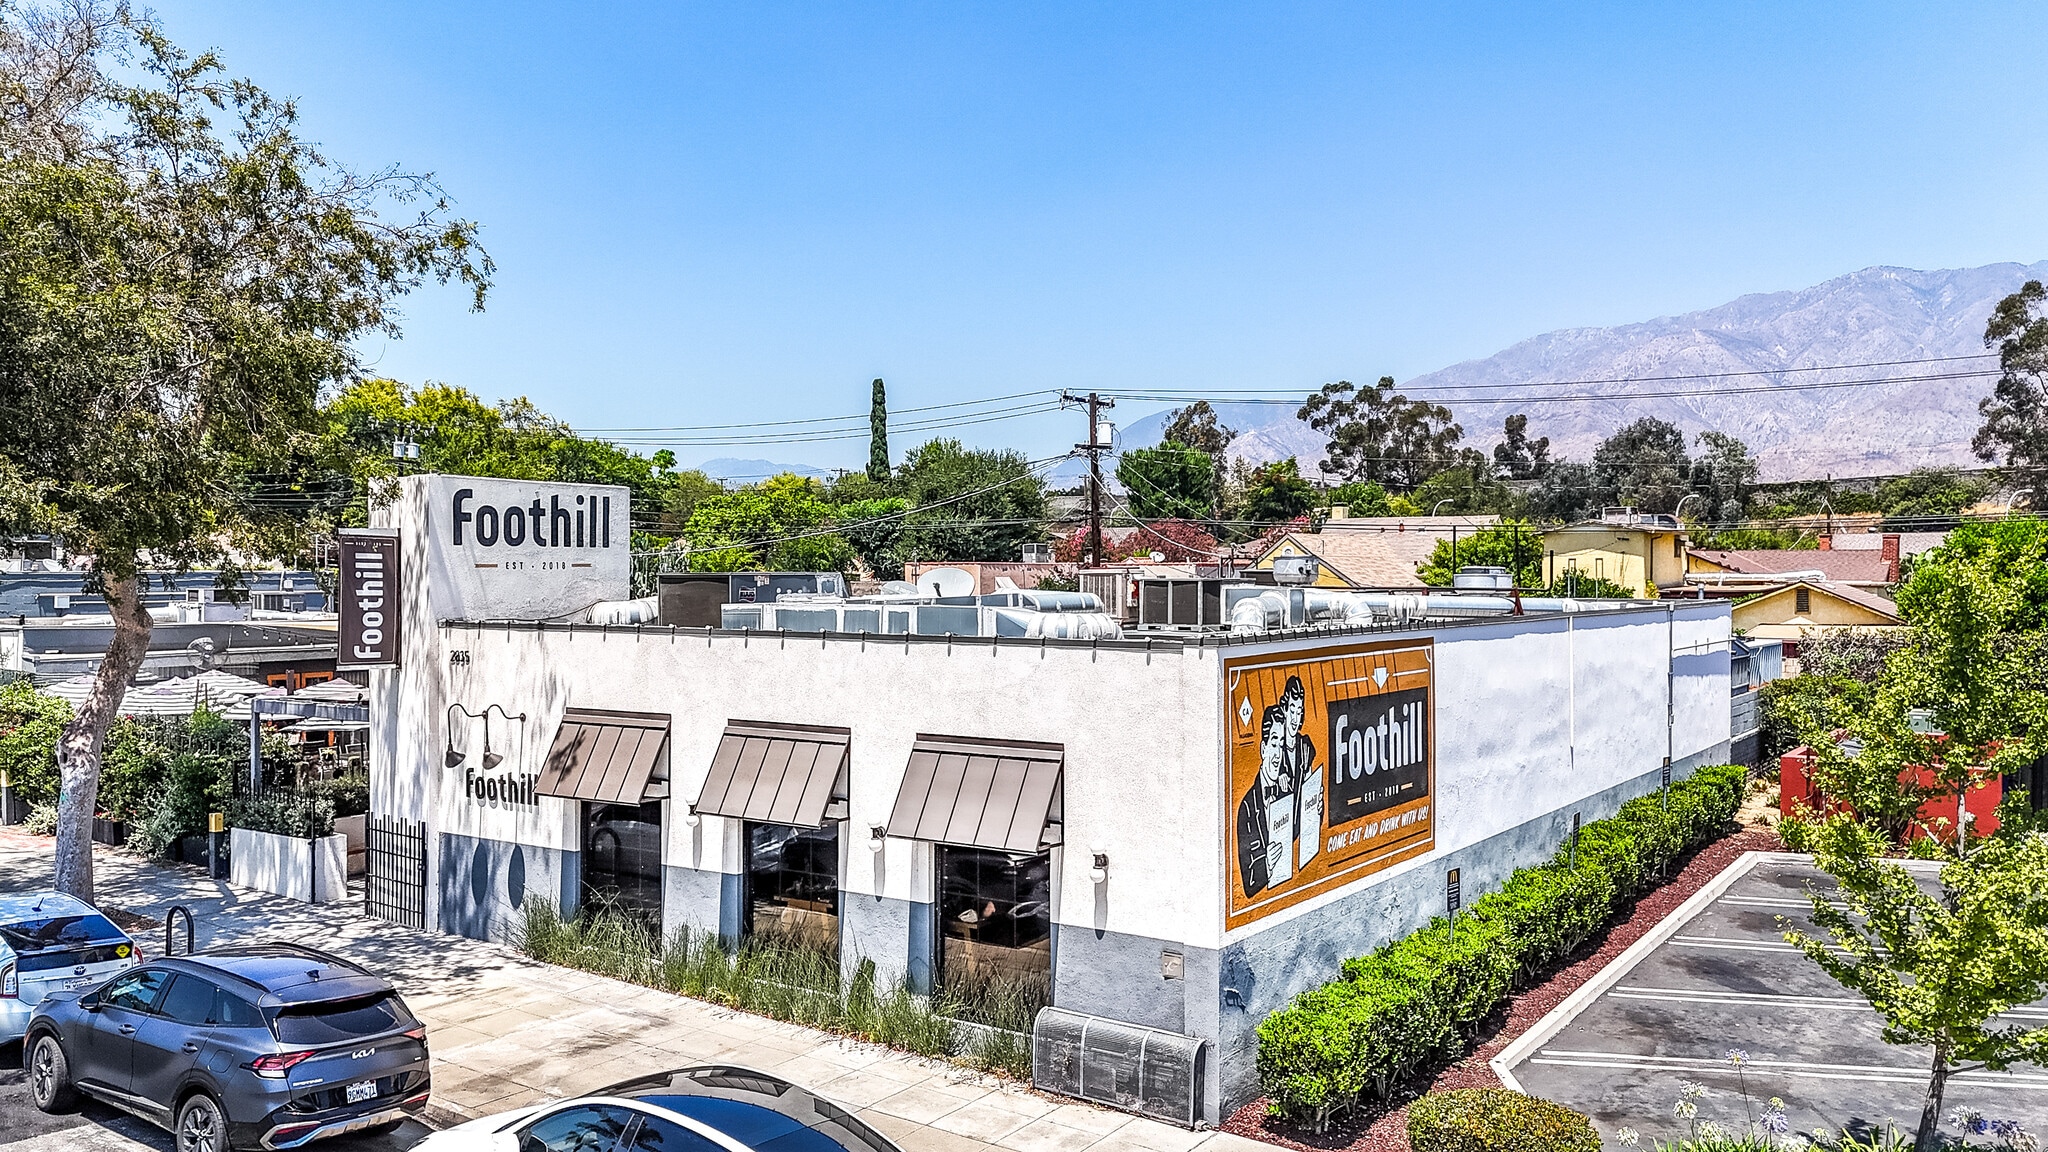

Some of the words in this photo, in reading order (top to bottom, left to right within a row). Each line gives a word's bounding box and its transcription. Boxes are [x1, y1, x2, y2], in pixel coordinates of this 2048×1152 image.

[453, 488, 610, 548] Foothill
[505, 561, 524, 570] EST
[542, 561, 566, 570] 2018
[353, 552, 384, 659] Foothill
[1242, 708, 1249, 716] CA
[1335, 701, 1423, 785] Foothill
[1364, 790, 1376, 803] EST
[1327, 832, 1347, 853] COME
[1349, 826, 1363, 845] EAT
[1363, 821, 1379, 840] AND
[1379, 814, 1401, 835] DRINK
[1401, 808, 1417, 828] WITH
[1417, 805, 1429, 821] US!
